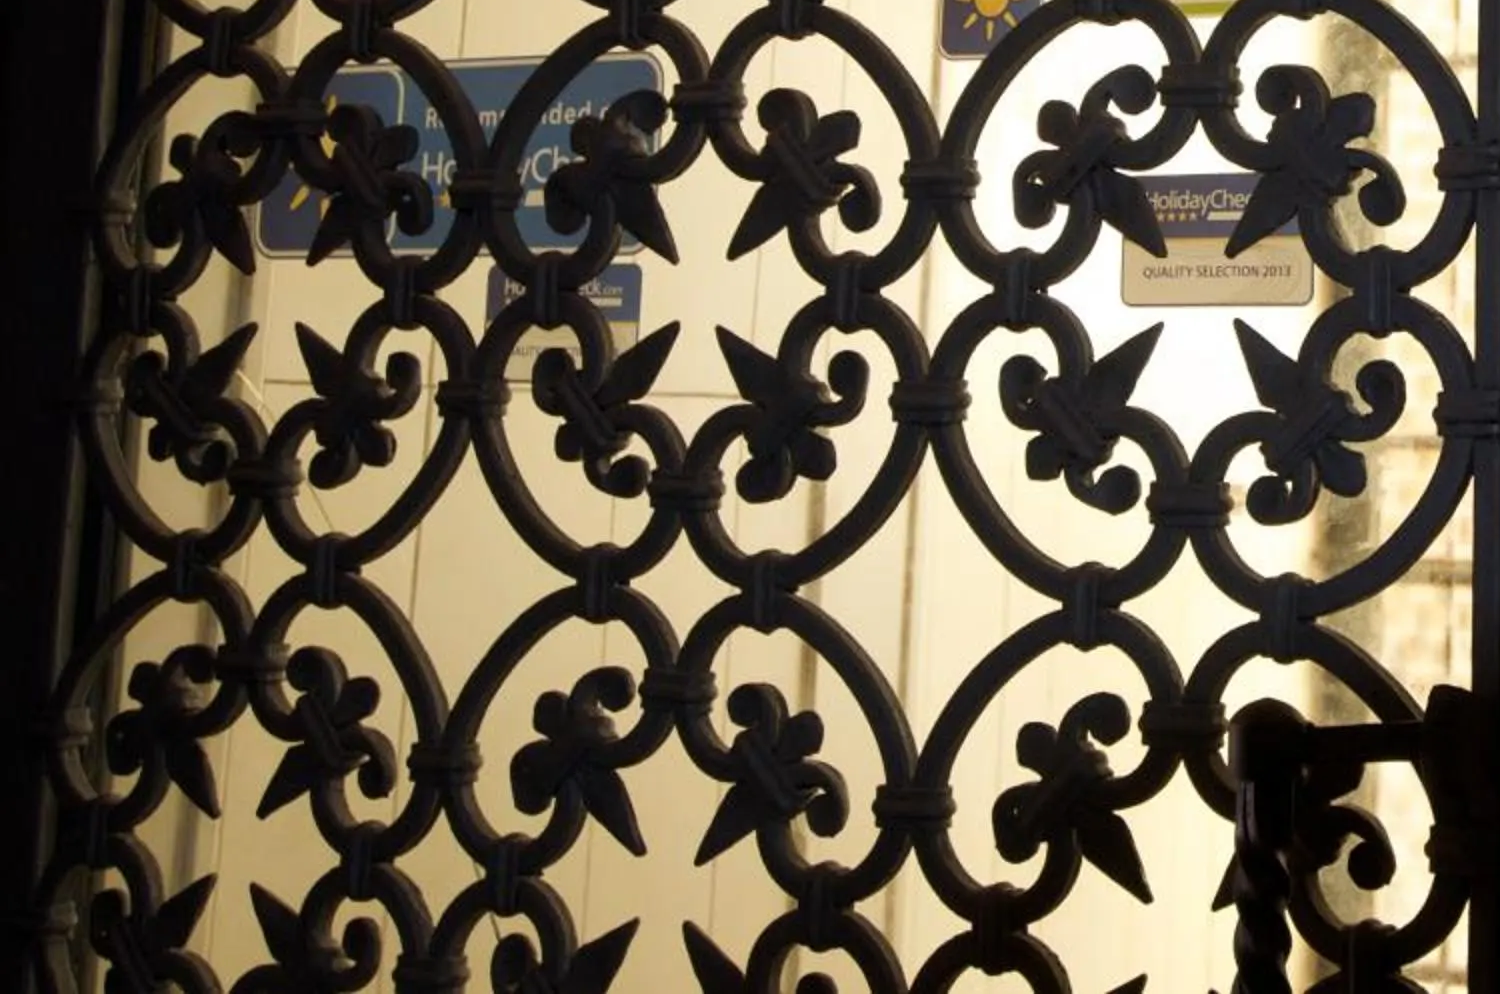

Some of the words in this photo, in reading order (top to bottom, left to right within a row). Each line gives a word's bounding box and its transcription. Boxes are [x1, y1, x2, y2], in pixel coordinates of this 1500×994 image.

[1144, 265, 1192, 279] QUALITY
[1196, 264, 1259, 278] SELECTION
[1262, 264, 1291, 277] 2013
